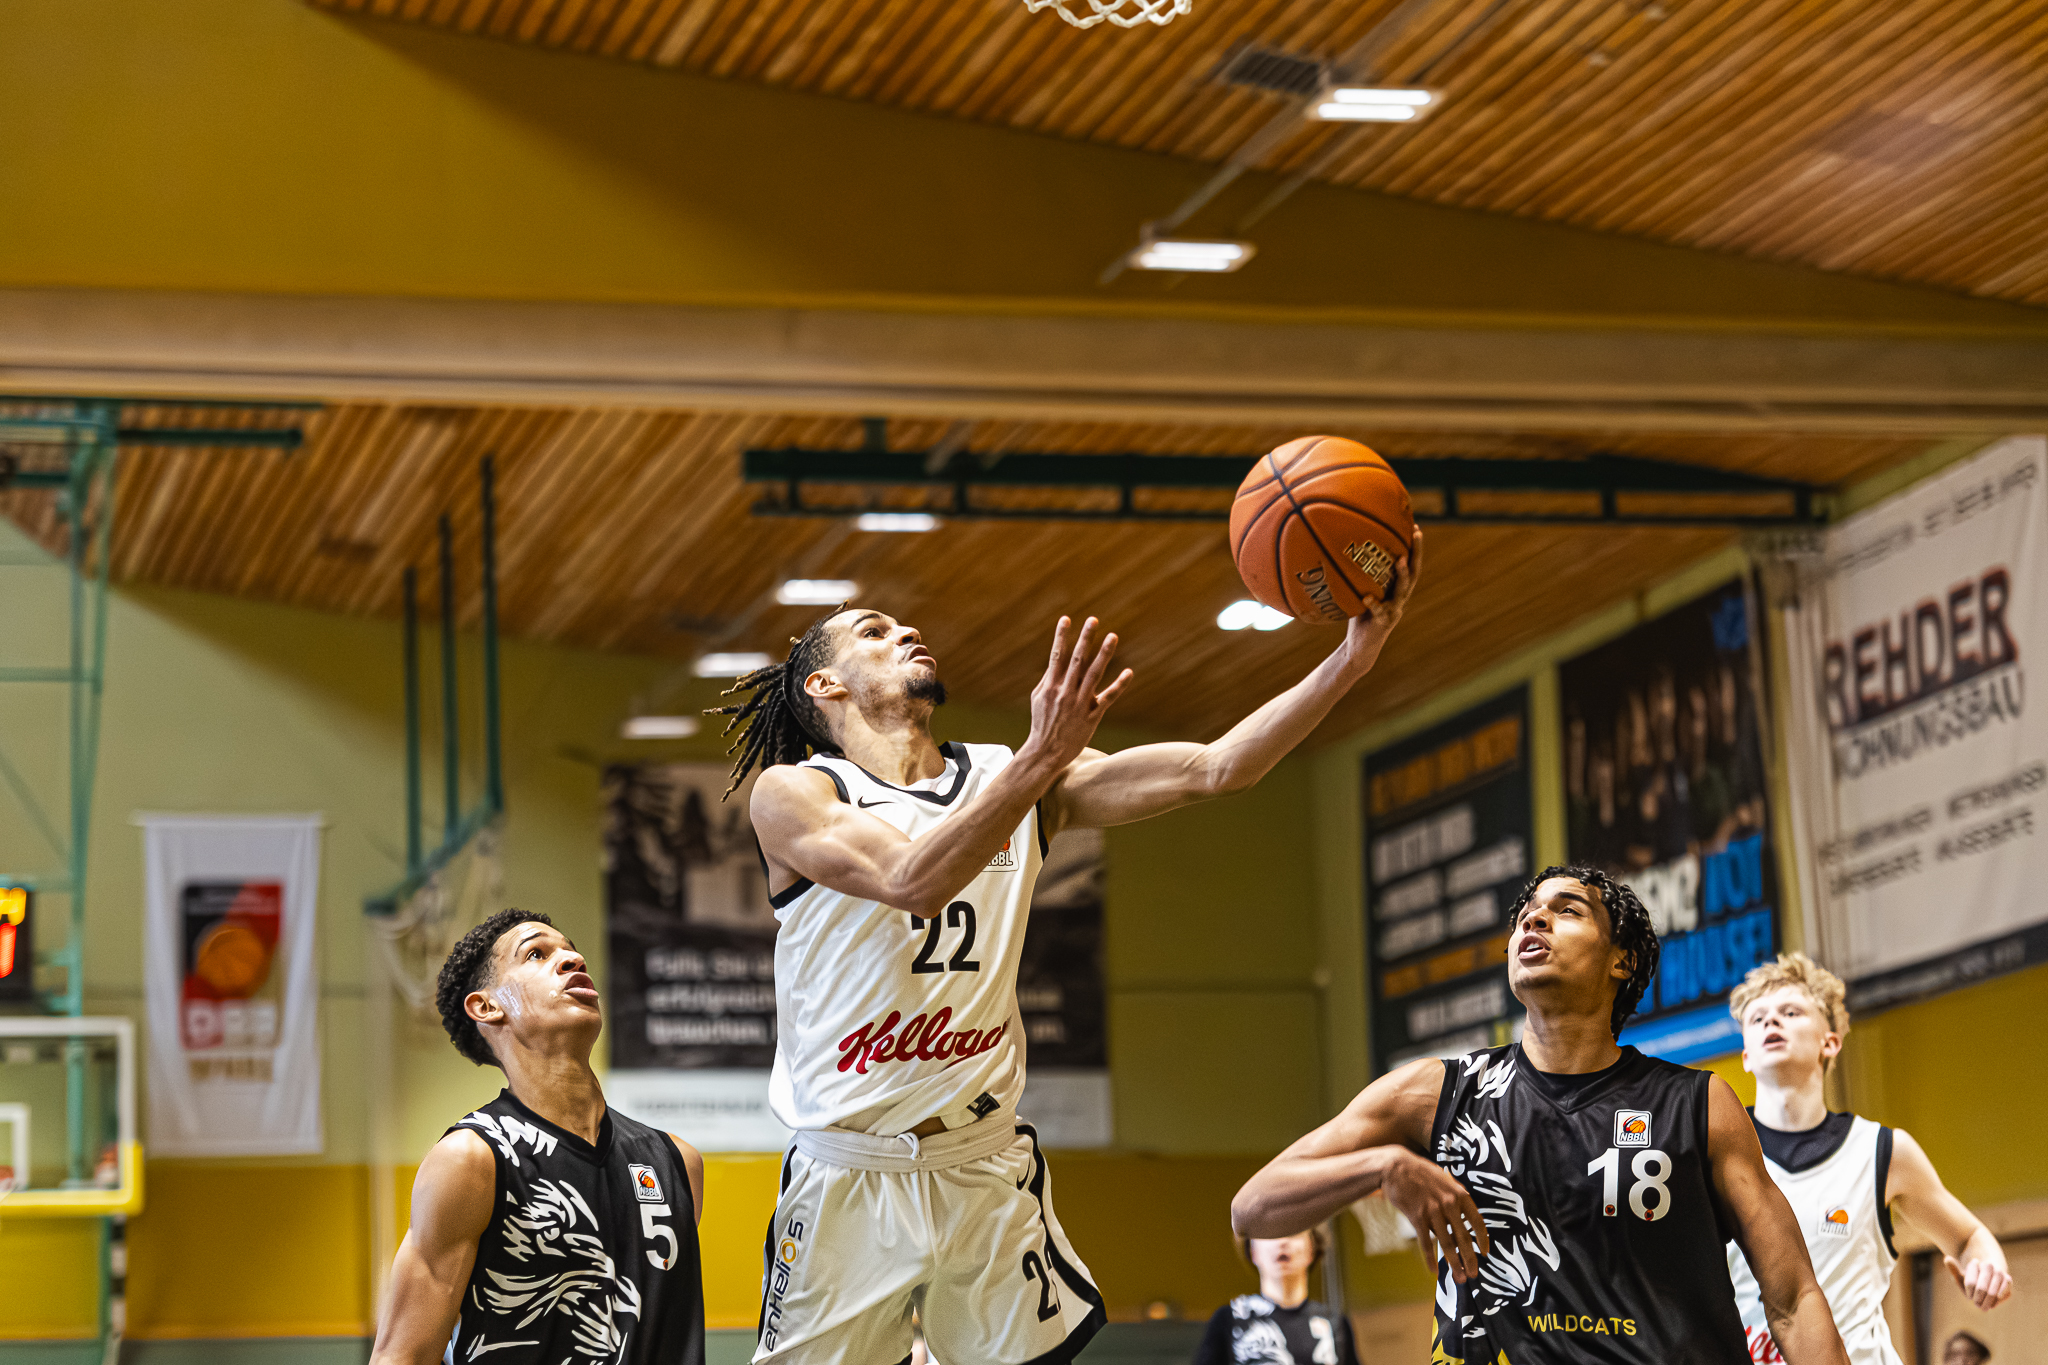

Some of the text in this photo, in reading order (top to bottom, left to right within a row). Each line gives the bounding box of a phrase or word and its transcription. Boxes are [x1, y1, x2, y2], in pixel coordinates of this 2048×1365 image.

[1823, 563, 2020, 737] REHDER
[1835, 668, 2027, 780] OHNUNGSBAU
[988, 851, 1013, 867] BBL
[911, 901, 980, 974] 22
[1619, 1131, 1646, 1142] NBBL
[1588, 1148, 1672, 1221] 18
[640, 1203, 678, 1271] 5
[1527, 1313, 1637, 1336] WILDCATS
